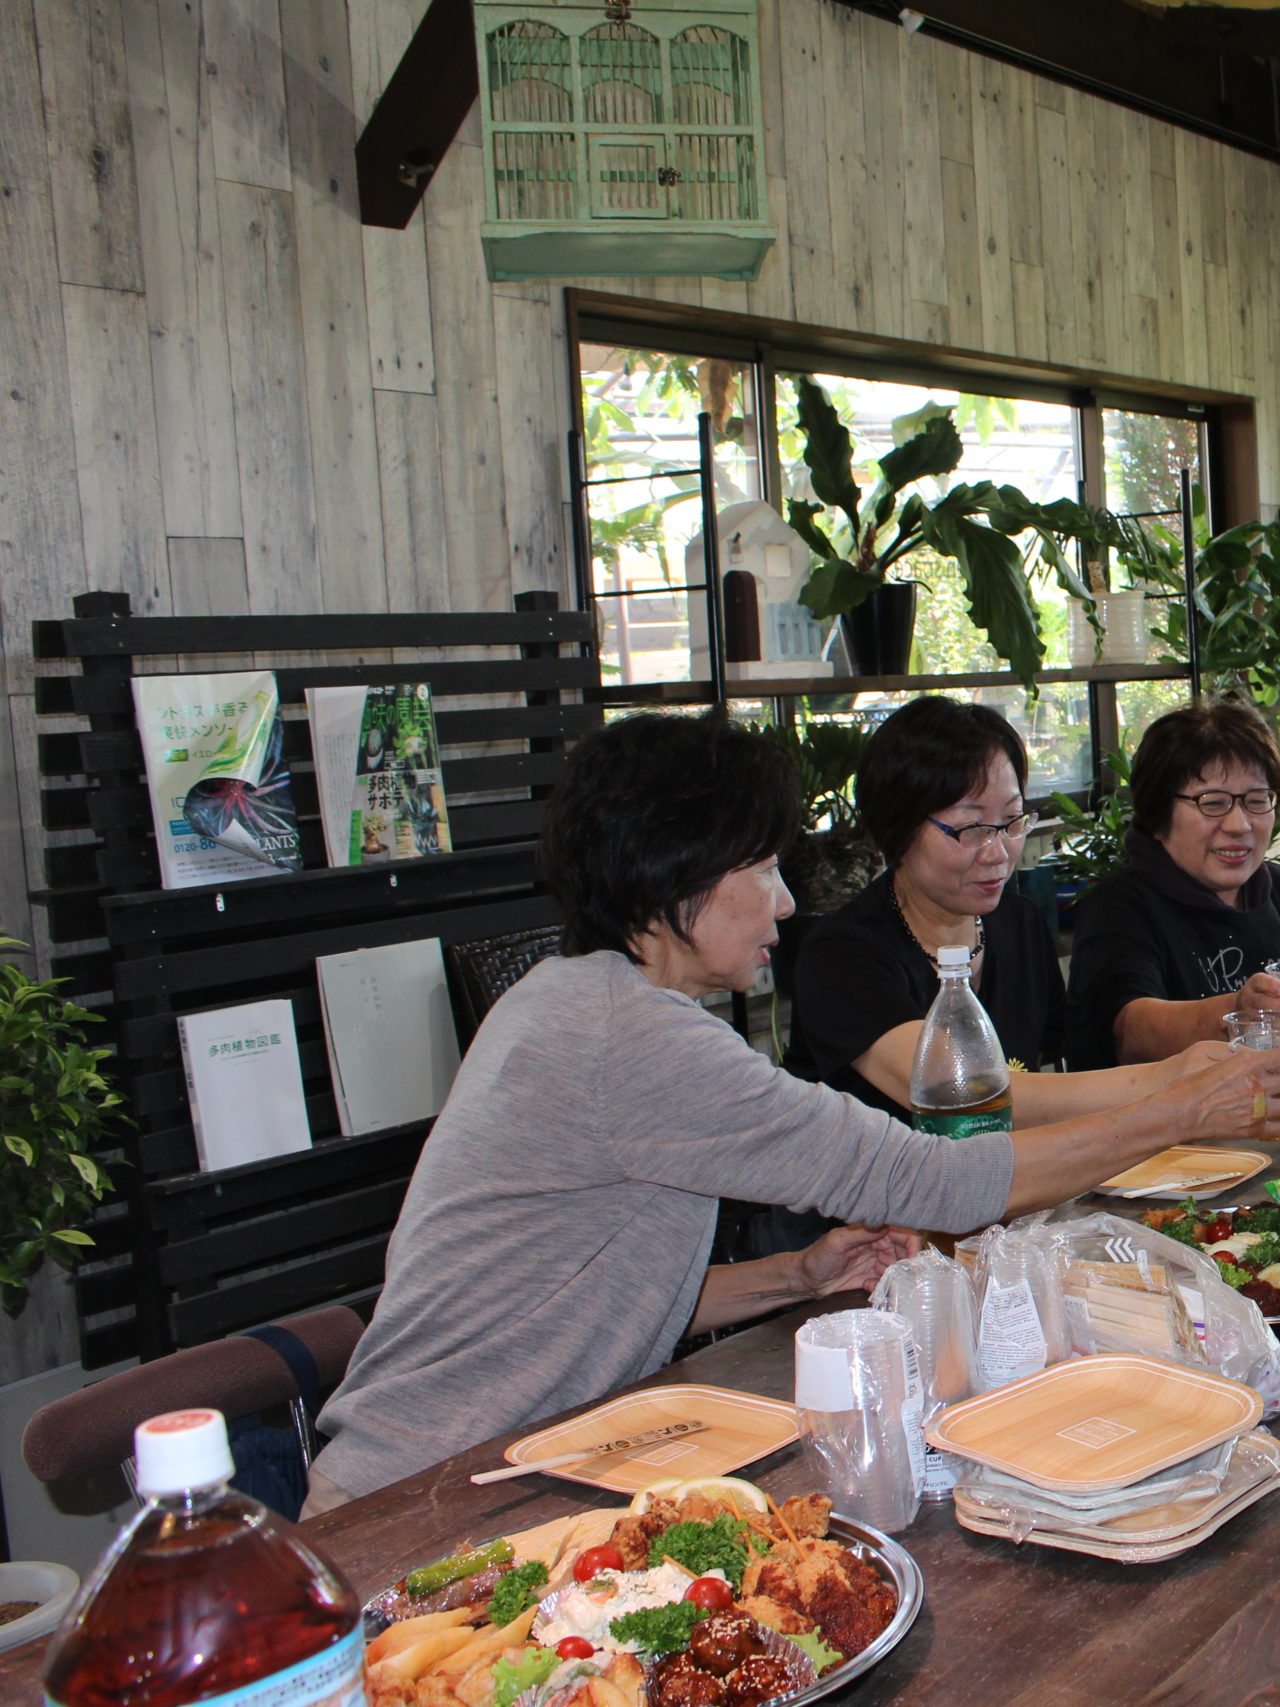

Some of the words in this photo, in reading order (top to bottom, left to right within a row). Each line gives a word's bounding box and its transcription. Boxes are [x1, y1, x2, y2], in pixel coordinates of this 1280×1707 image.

[256, 834, 296, 851] LANTS
[208, 1033, 282, 1058] 多肉植物図鑑
